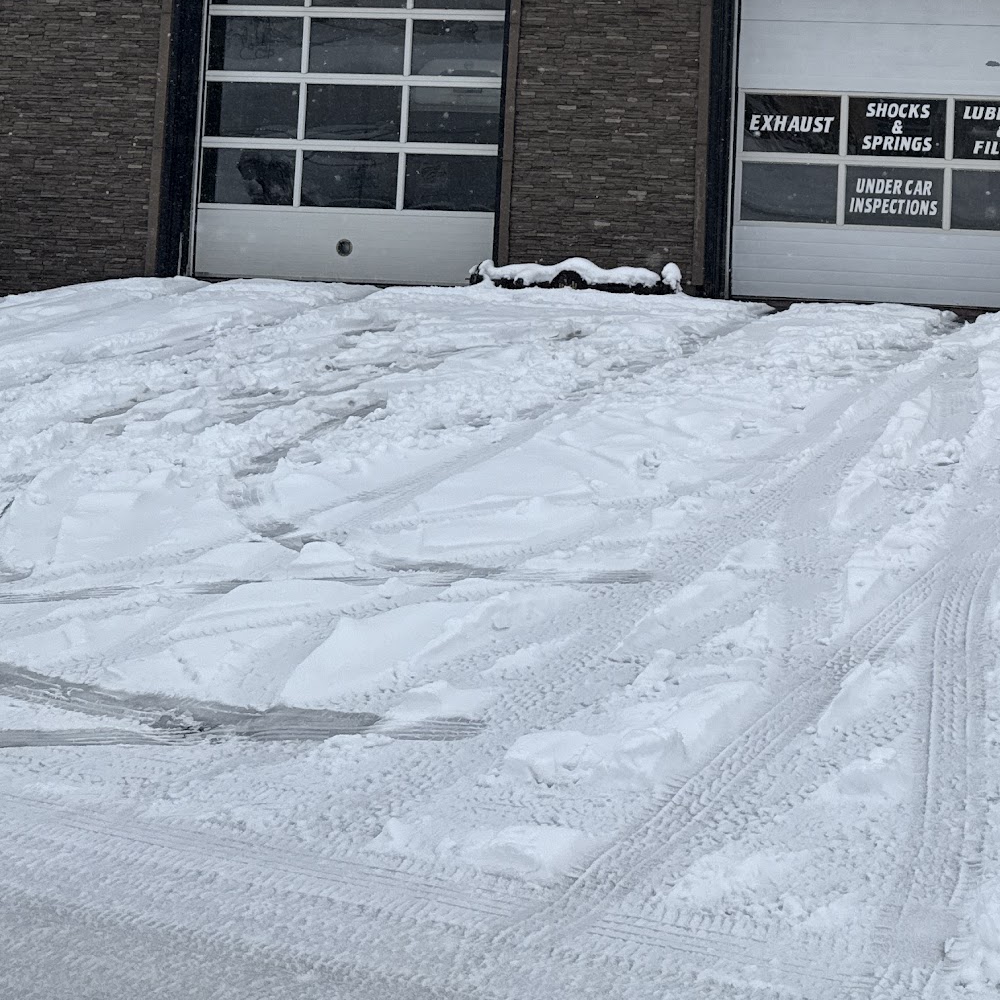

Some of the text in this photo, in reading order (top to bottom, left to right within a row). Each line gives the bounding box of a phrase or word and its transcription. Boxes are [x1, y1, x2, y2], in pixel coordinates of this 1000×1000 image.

[866, 102, 931, 119] SHOCKS
[749, 114, 834, 133] EXHAUST
[891, 119, 904, 134] &
[861, 135, 933, 152] SPRINGS
[856, 178, 932, 196] UNDER CAR
[849, 197, 938, 216] INSPECTIONS
